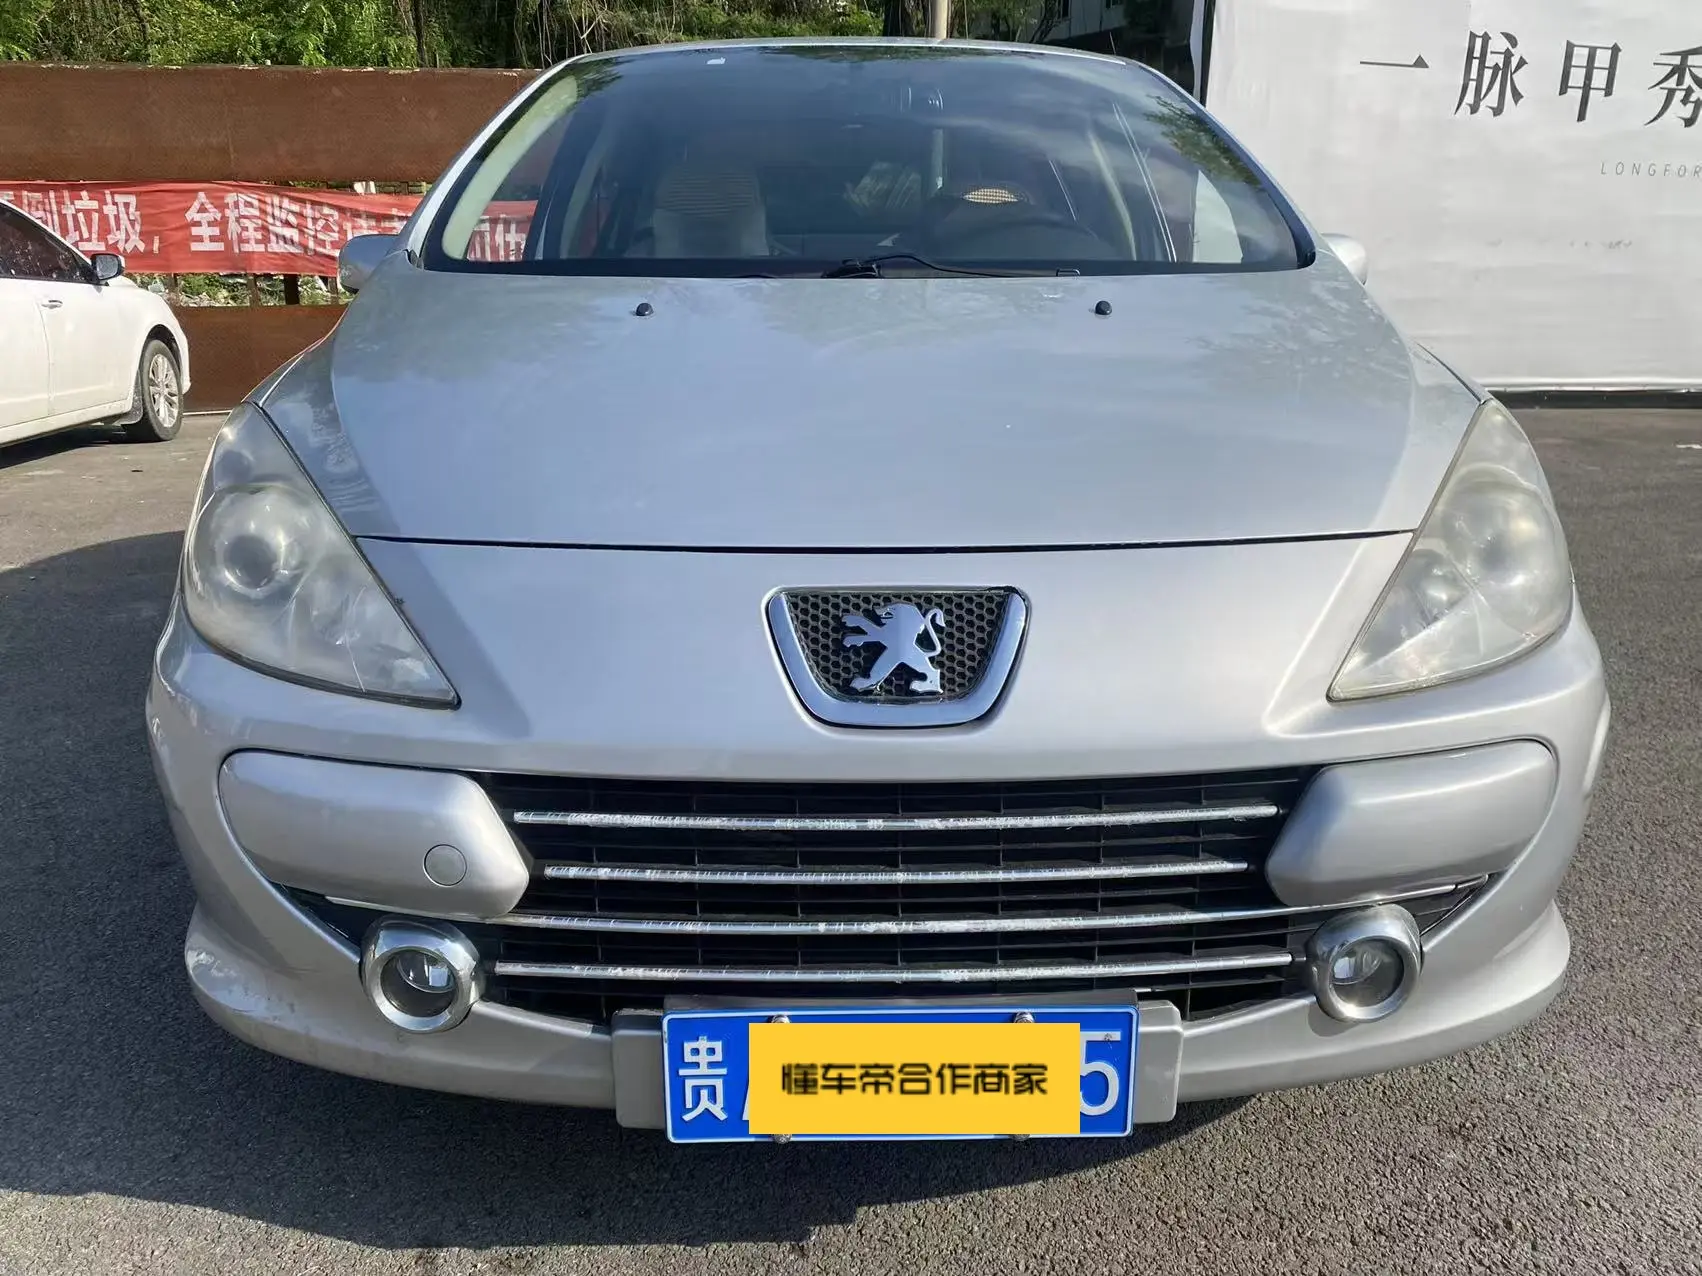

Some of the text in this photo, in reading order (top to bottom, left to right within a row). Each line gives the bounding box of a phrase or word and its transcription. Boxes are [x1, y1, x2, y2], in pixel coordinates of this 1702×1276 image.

[1359, 29, 1702, 128] 一脉甲秀
[1600, 161, 1702, 179] LONGFOR
